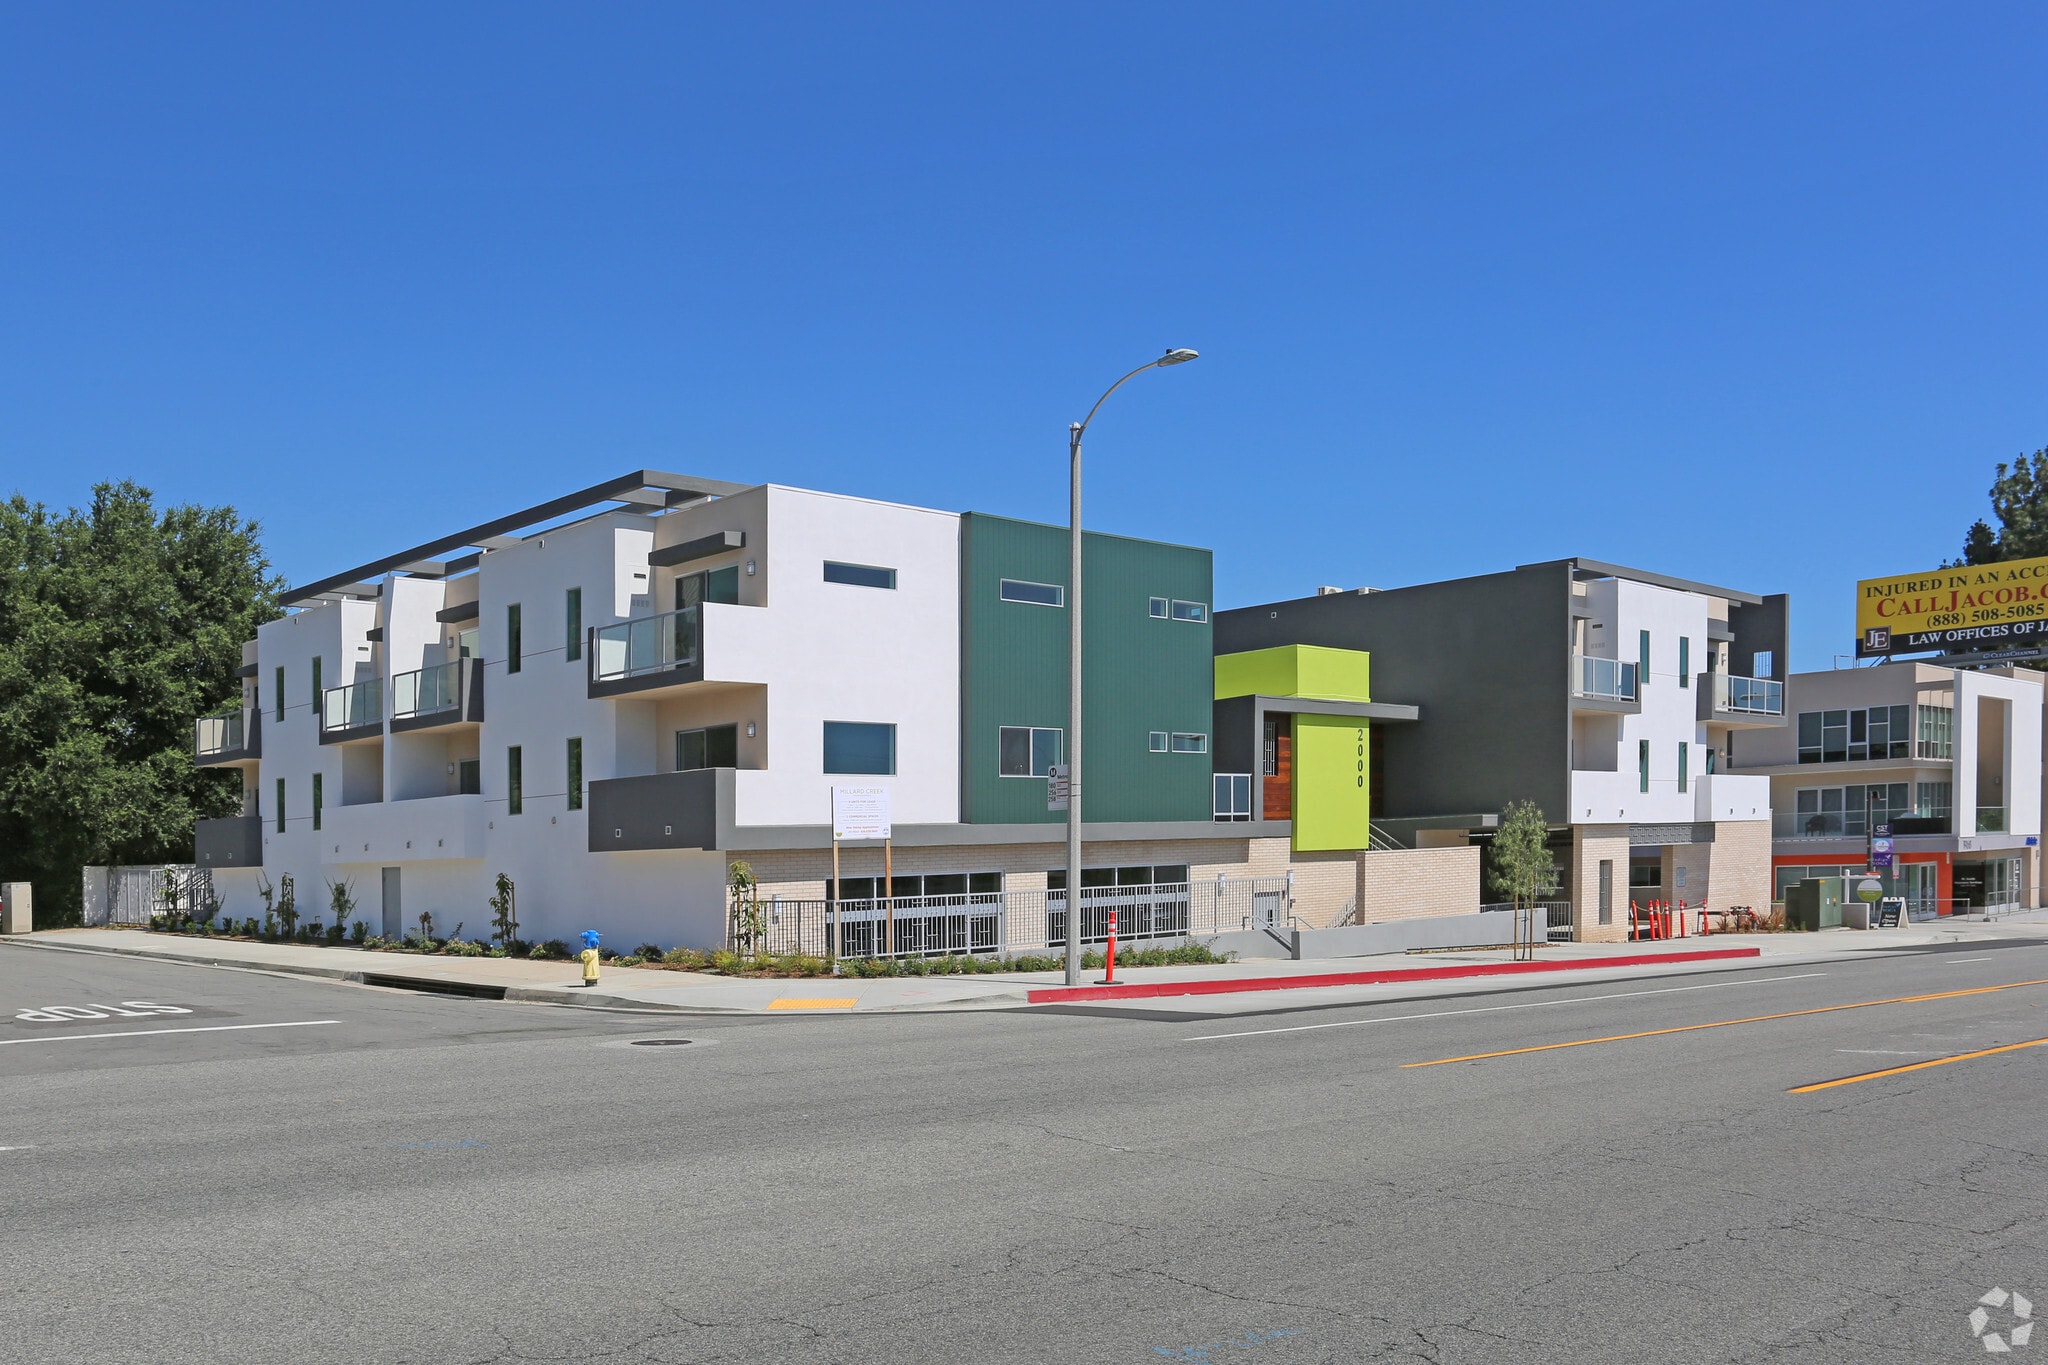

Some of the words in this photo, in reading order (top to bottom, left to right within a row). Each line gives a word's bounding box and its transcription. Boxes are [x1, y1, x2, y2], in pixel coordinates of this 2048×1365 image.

[1866, 578, 1942, 598] INJURED
[1949, 575, 1967, 588] IN
[1974, 571, 1999, 585] AN
[1926, 612, 1966, 629] (888)
[1971, 603, 2045, 623] 508-5085
[1909, 631, 1943, 646] LAW
[1946, 625, 2009, 642] OFFICES
[2013, 622, 2035, 635] OF
[15, 1001, 194, 1022] STOP
